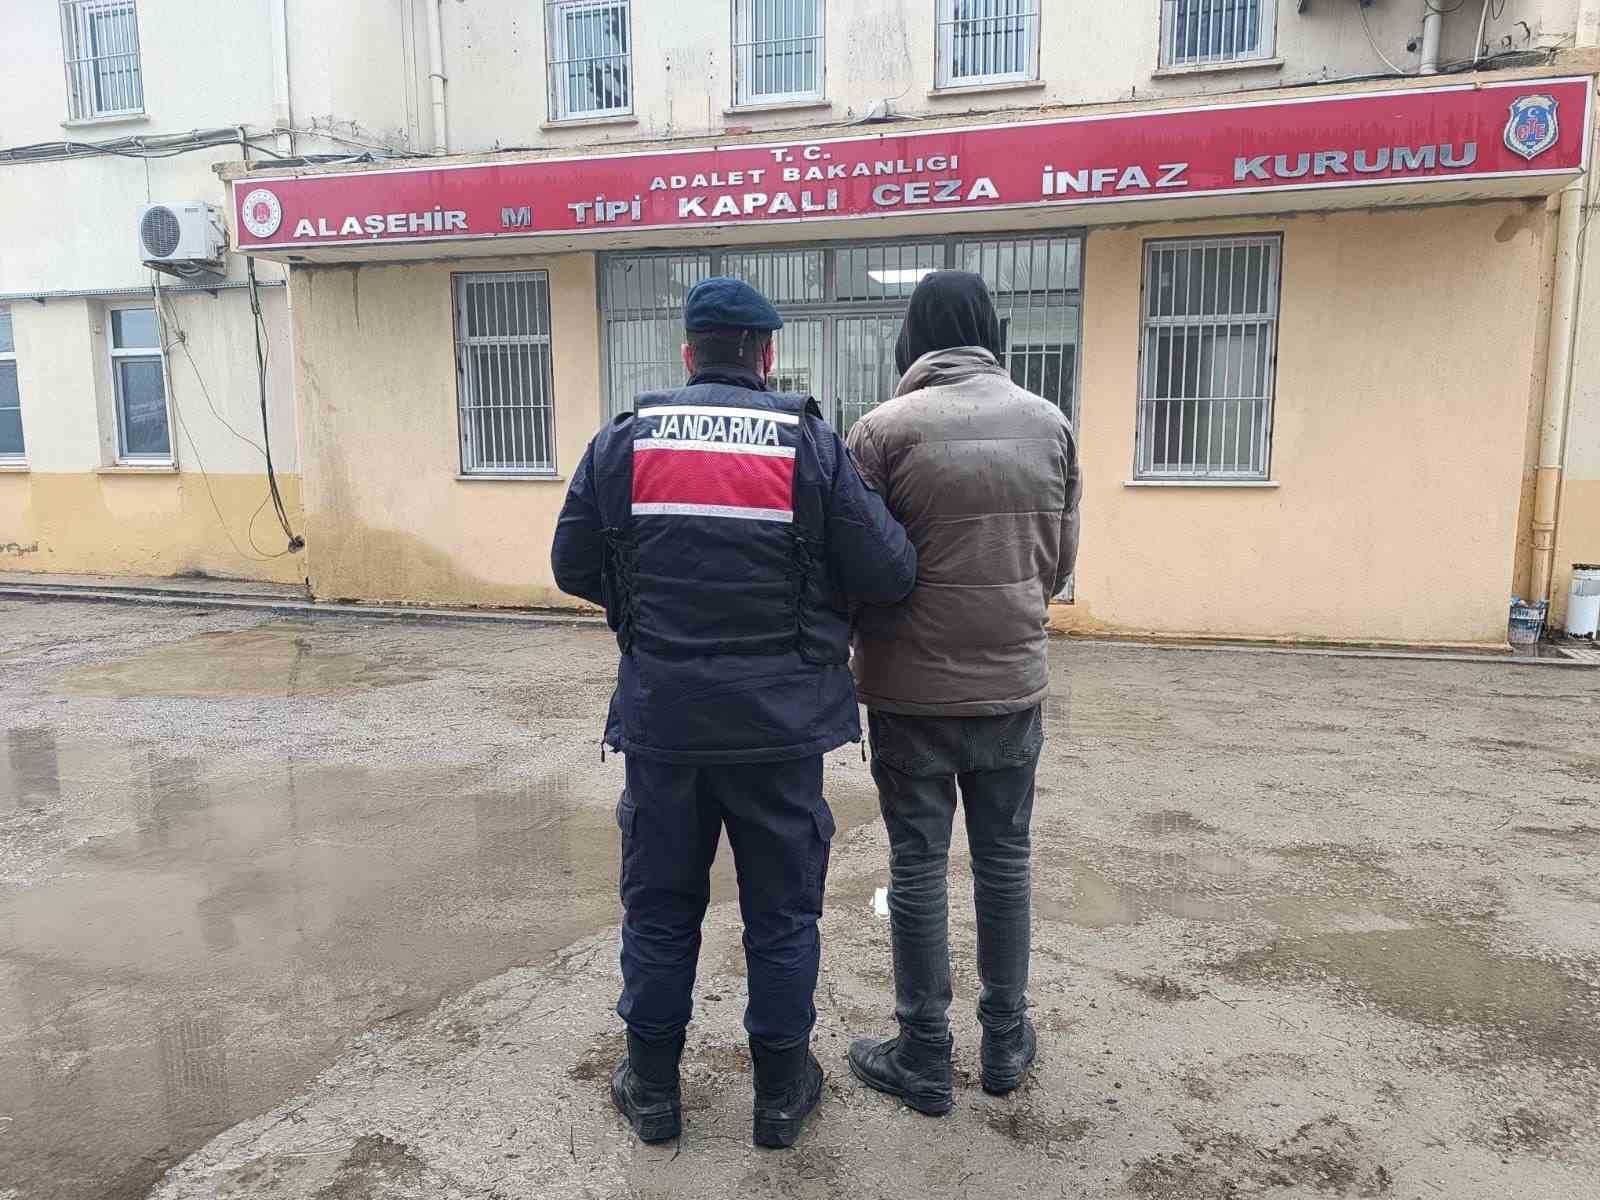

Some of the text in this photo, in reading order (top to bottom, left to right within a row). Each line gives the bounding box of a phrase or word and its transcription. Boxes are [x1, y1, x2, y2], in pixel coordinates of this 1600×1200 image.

[293, 142, 1478, 239] ALAŞEHİR M TİPİ KAPALI CEZA İNFAZ KURUMU
[649, 169, 766, 191] ADALET
[651, 414, 780, 446] JANDARMA
